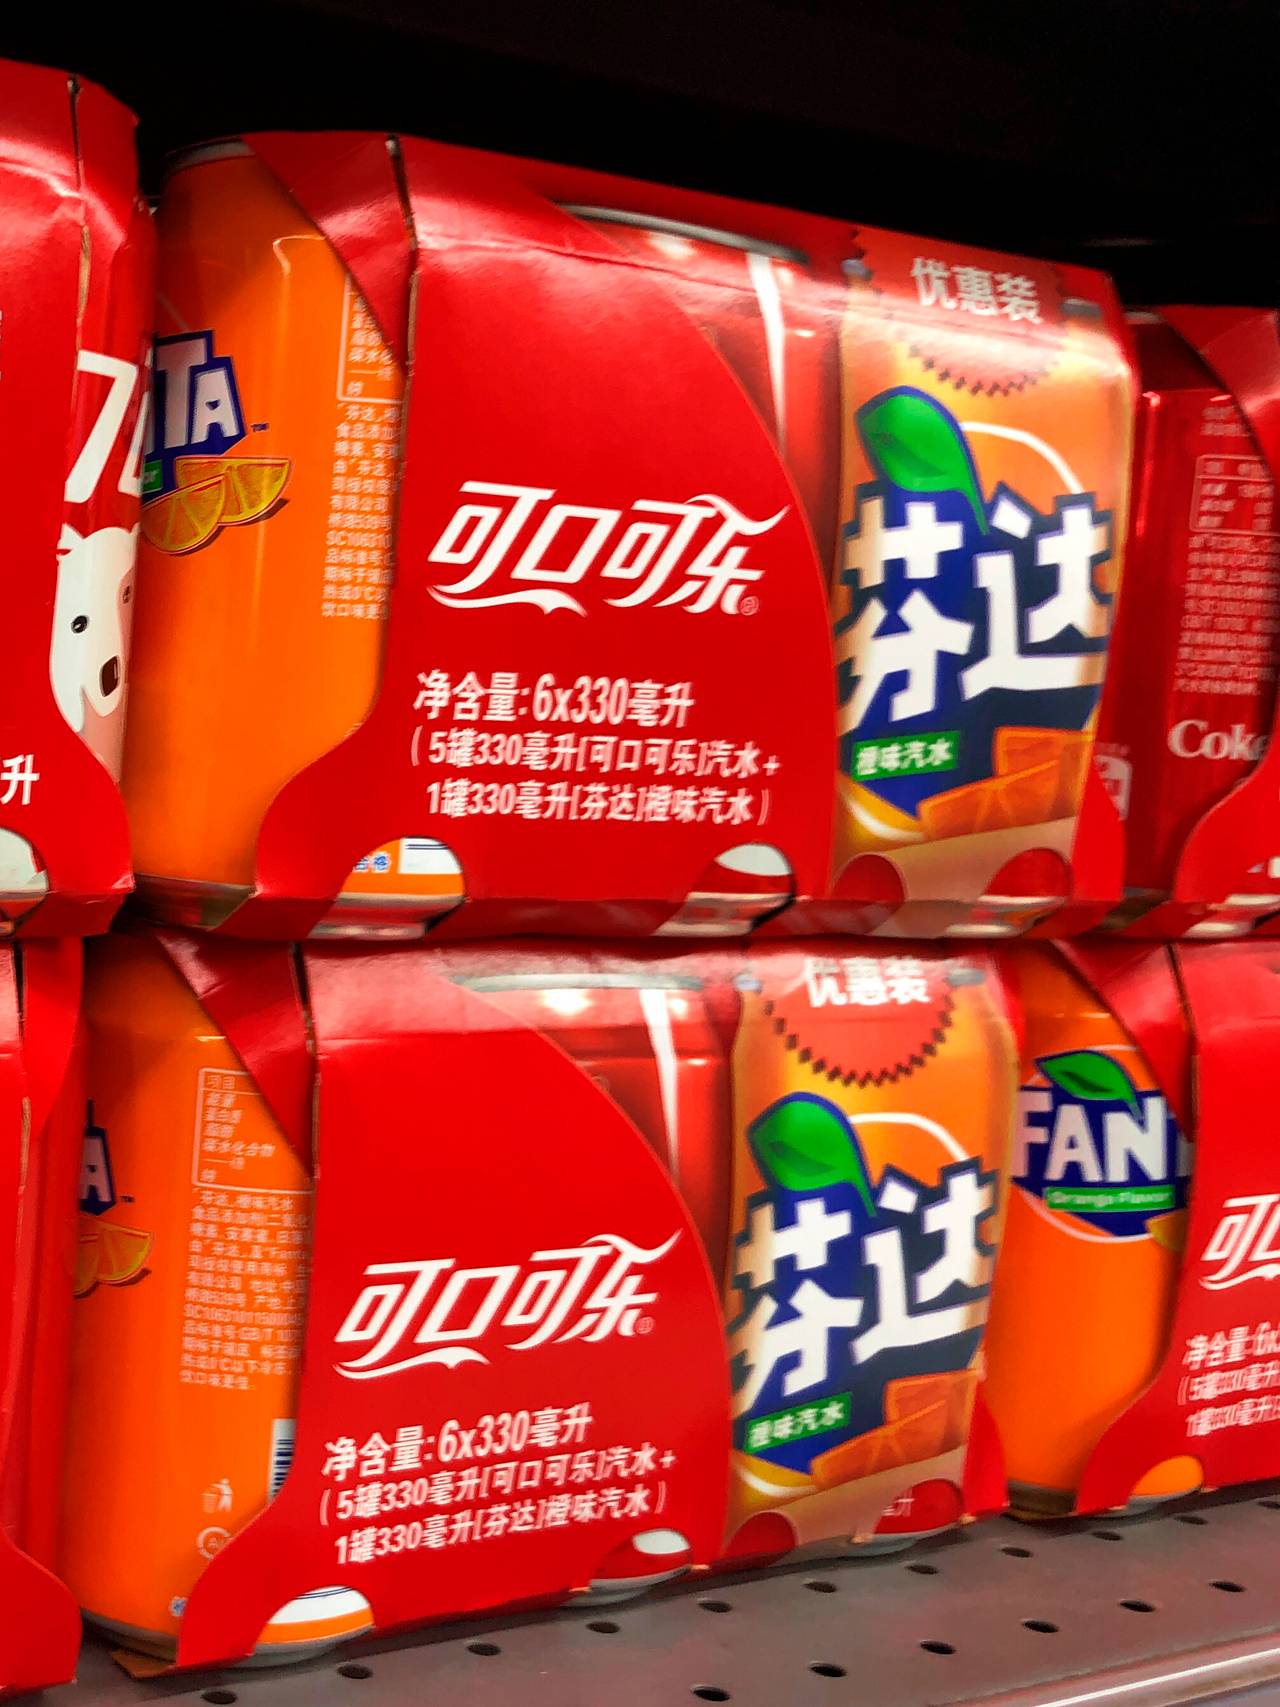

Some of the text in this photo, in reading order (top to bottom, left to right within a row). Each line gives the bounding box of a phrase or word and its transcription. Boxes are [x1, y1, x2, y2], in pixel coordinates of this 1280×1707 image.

[911, 256, 1043, 324] 优惠装
[145, 338, 240, 455] TA
[428, 481, 790, 617] 可口可乐
[836, 493, 1112, 734] 芬达
[413, 669, 696, 728] 净含量:6x330毫升
[1009, 1089, 1194, 1183] FAN
[334, 1231, 683, 1379] 可口可乐
[731, 1171, 994, 1417] 芬达
[321, 1402, 593, 1481] 净含量:6x330毫升
